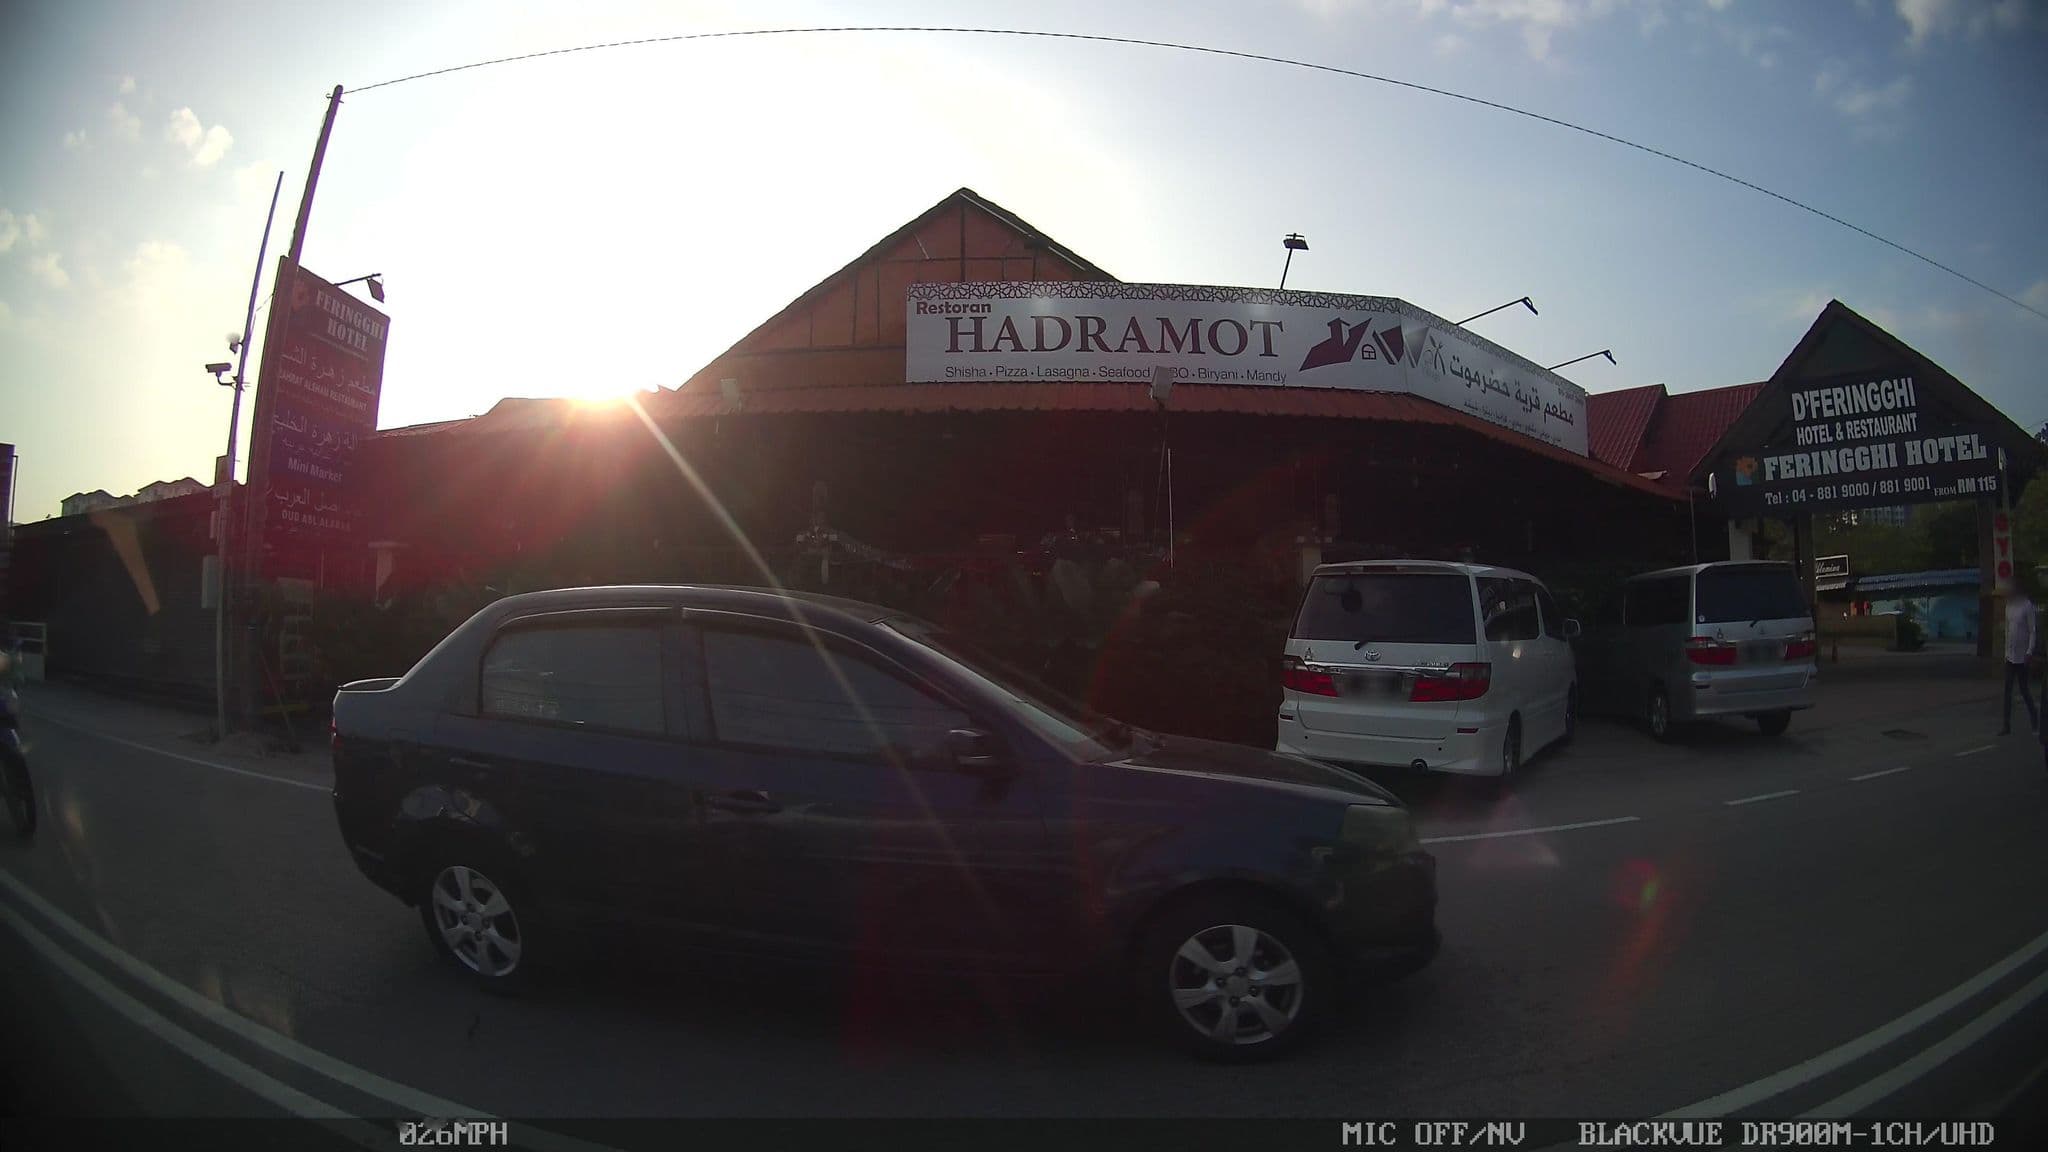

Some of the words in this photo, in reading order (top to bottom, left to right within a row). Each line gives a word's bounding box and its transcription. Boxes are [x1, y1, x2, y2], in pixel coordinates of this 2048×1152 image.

[316, 289, 385, 340] FERINGGHI
[916, 300, 992, 315] Restoran
[327, 318, 368, 352] HOTEL
[945, 315, 1284, 358] HADRAMOT
[945, 366, 987, 379] Shisha
[995, 366, 1028, 378] Pizza
[1037, 366, 1090, 381] Lasagna
[1099, 366, 1151, 379] Seafood
[1198, 367, 1238, 382] Biryani
[1247, 369, 1287, 384] Mandy
[1449, 355, 1510, 398] حضرموت
[1514, 378, 1541, 413] قرية
[1791, 377, 1917, 421] D'FERINGGHI
[1543, 401, 1574, 427] مطعم
[1796, 423, 1834, 446] HOTEL
[1835, 421, 1845, 441] &
[1845, 412, 1918, 439] RESTAURANT
[287, 456, 309, 473] Mini
[310, 464, 344, 482] Market
[1763, 442, 1898, 481] FERINGGHI
[1904, 433, 1988, 466] HOTEL
[1791, 488, 1807, 502] 04
[1817, 485, 1838, 500] 881
[1841, 482, 1870, 498] 9000
[1879, 479, 1900, 494] 881
[1903, 475, 1931, 492] 9001
[1934, 485, 1957, 497] FROM
[1957, 477, 1976, 494] RM
[1977, 475, 1997, 492] 115
